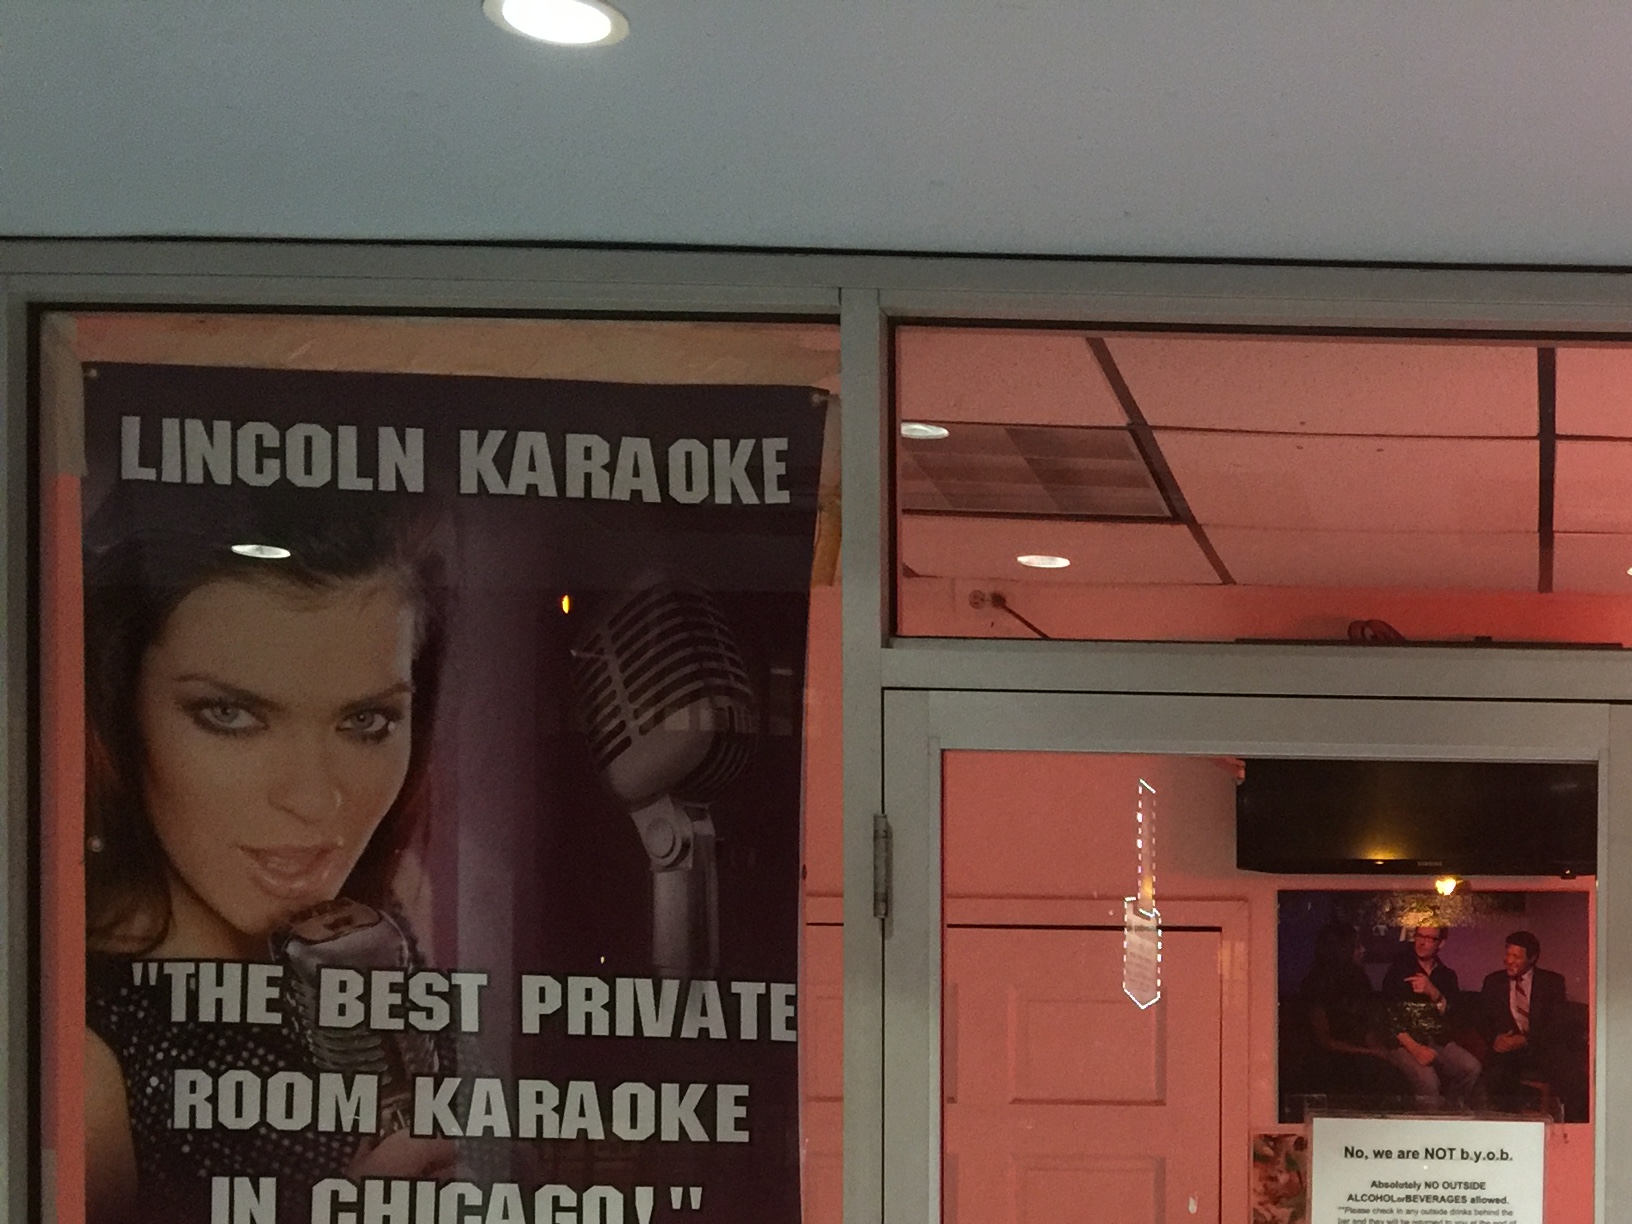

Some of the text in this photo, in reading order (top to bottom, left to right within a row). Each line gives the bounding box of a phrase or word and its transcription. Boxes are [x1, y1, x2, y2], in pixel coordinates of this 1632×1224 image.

[121, 415, 791, 505] LINCOLN KARAOKE
[132, 961, 798, 1042] "THE BEST PRIVATE
[172, 1068, 750, 1144] ROOM KARAOKE
[1344, 1146, 1513, 1163] No, we are NOT b.y.o.b.
[1371, 1180, 1421, 1191] Absolutely
[1442, 1182, 1486, 1190] OUTSIDE
[1470, 1195, 1509, 1204] allowed.
